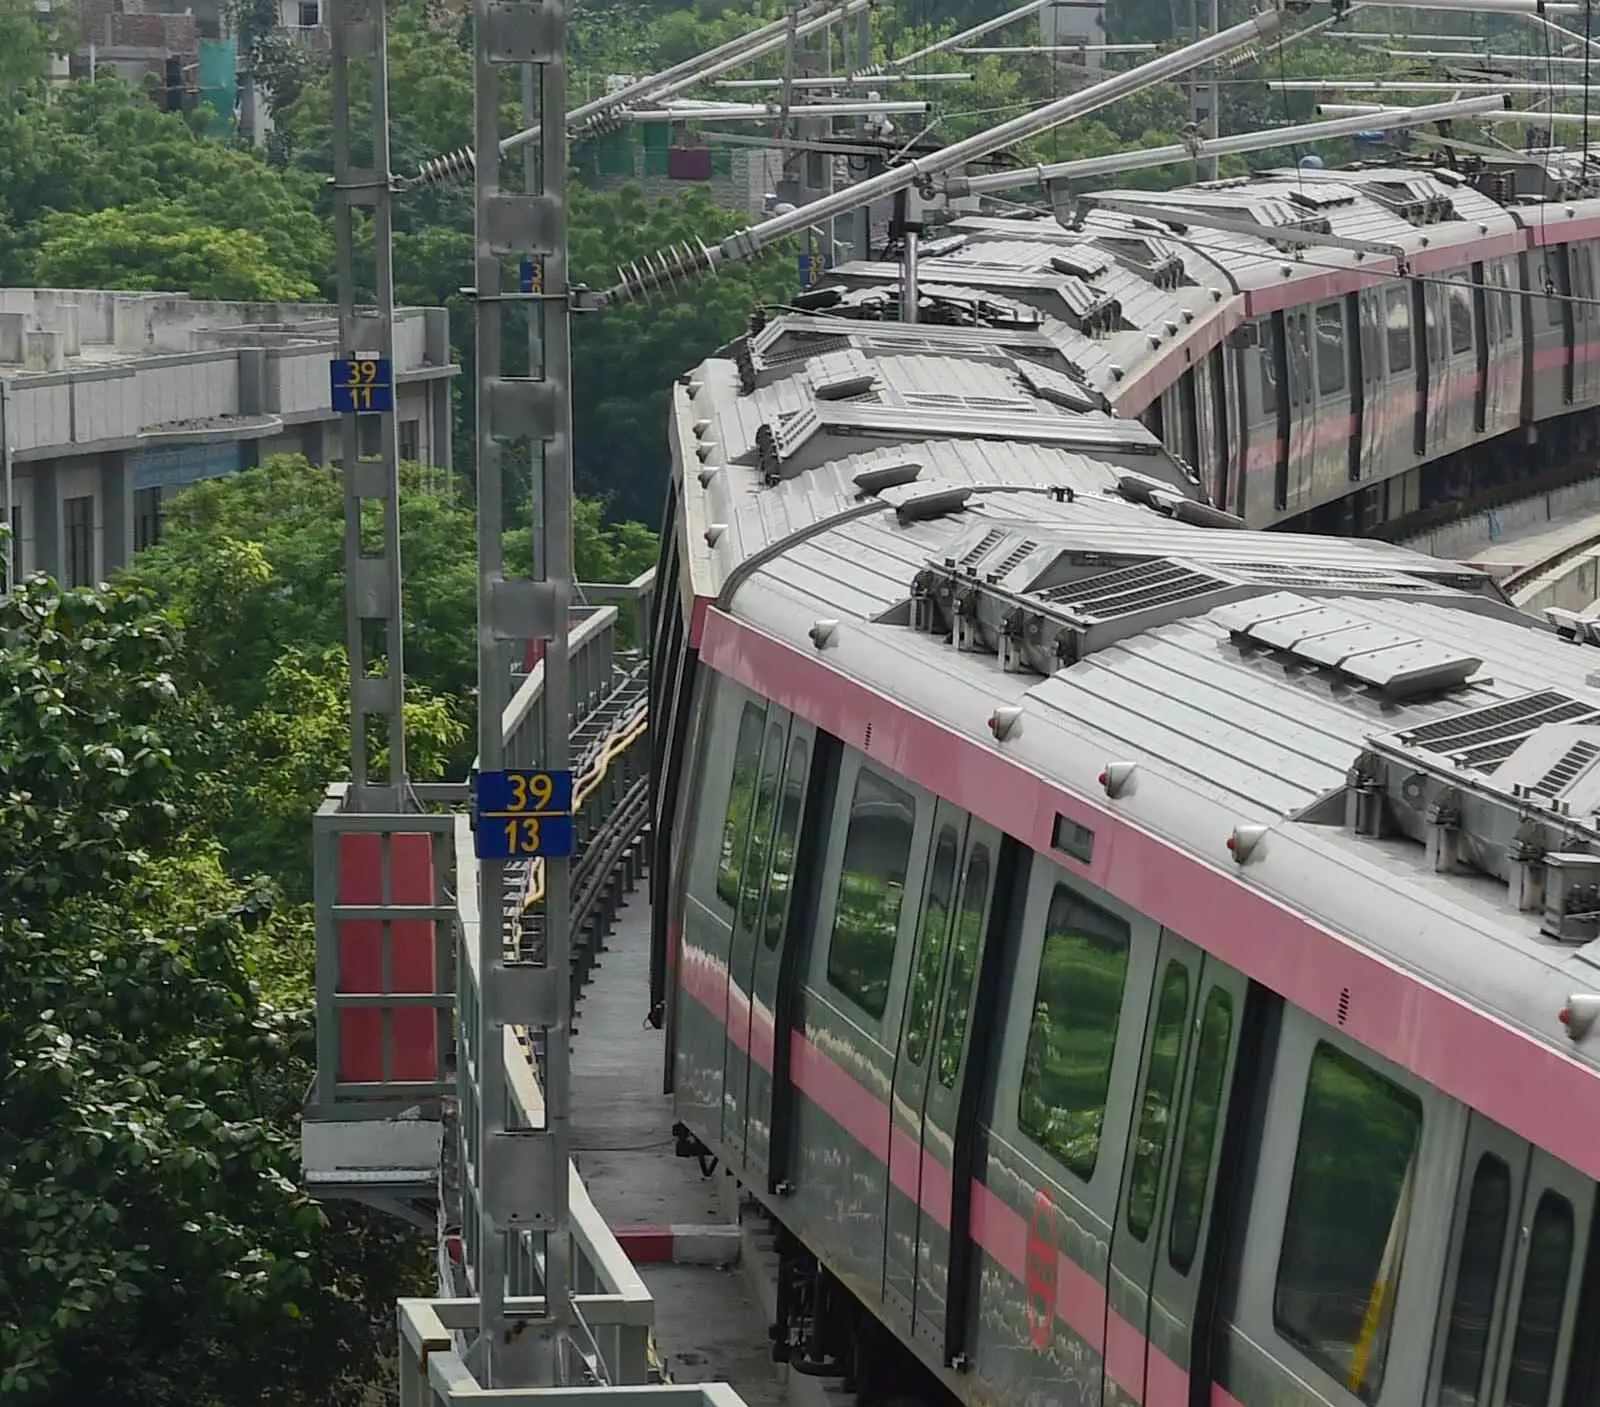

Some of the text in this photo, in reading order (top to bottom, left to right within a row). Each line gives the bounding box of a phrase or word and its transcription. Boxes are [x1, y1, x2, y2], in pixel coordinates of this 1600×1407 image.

[347, 360, 377, 385] 39
[350, 386, 371, 409] 11
[506, 774, 553, 812] 39
[504, 818, 540, 854] 13
